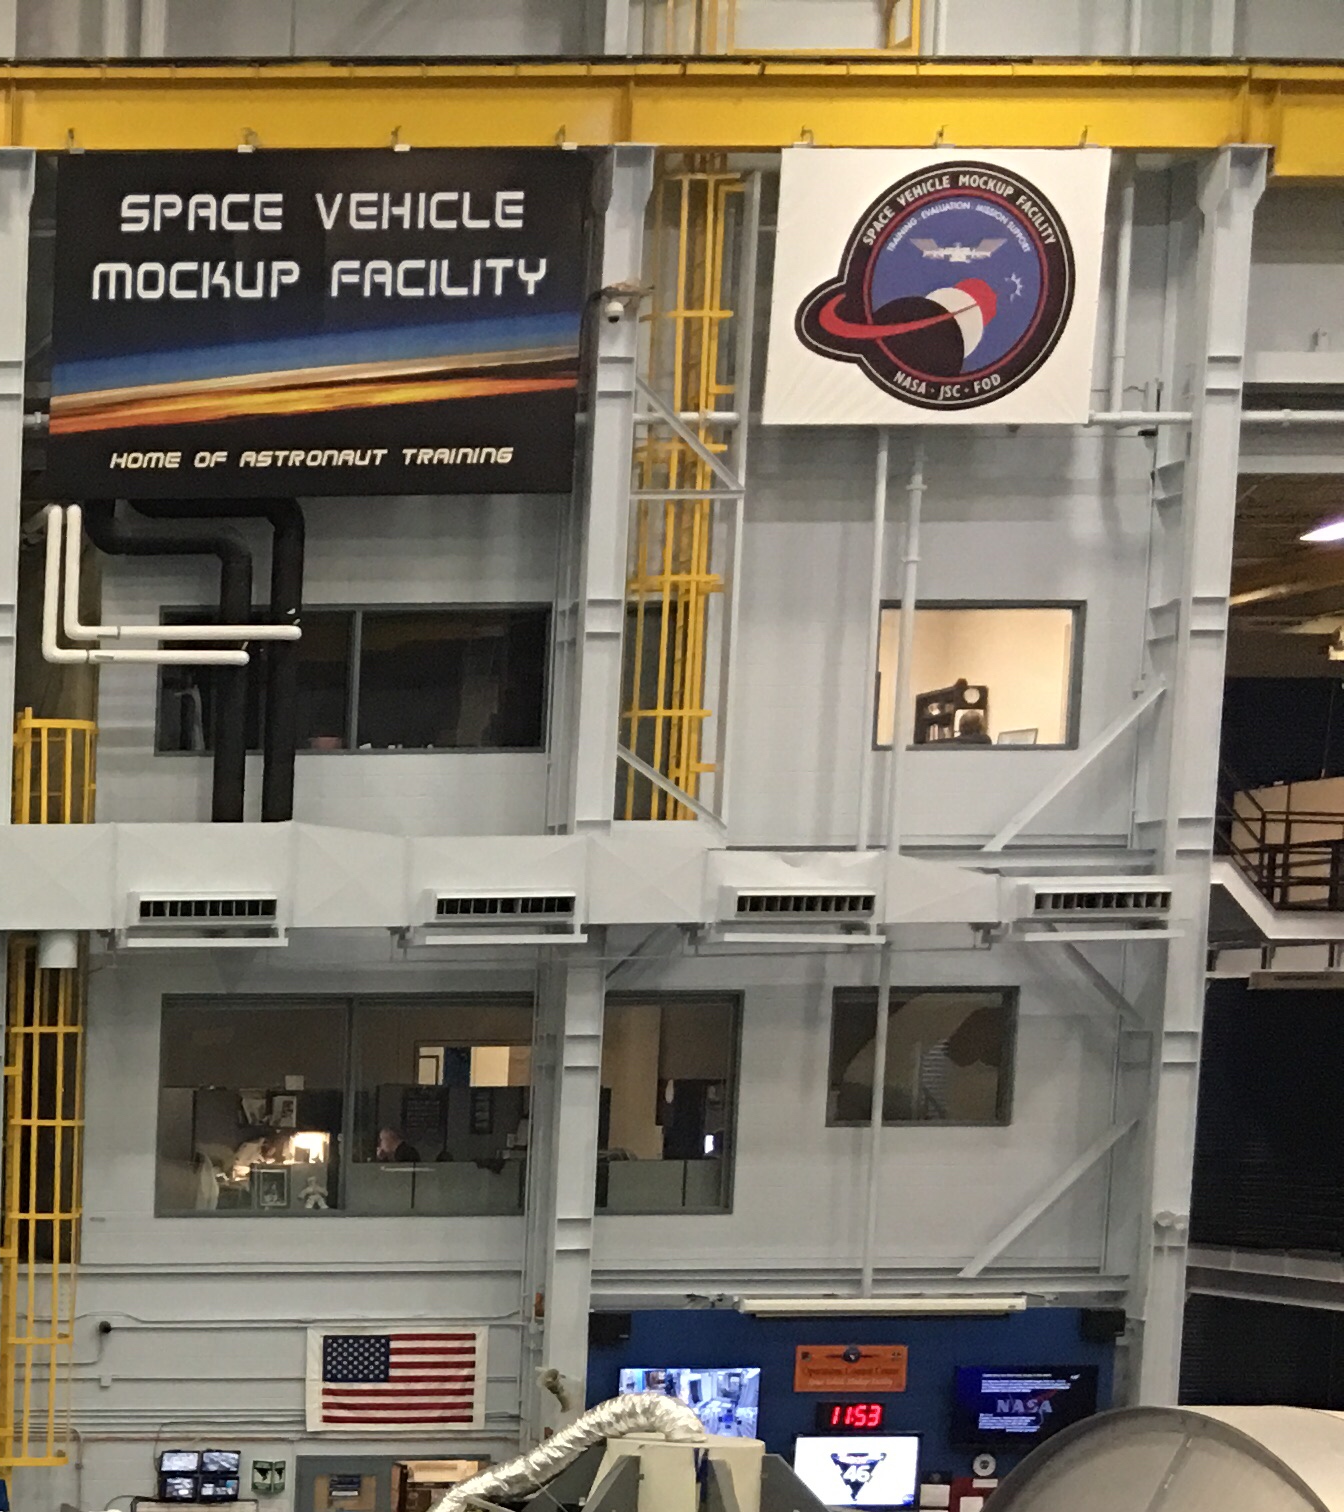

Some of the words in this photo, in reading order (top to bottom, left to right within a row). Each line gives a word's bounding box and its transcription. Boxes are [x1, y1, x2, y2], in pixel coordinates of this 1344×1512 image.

[119, 192, 284, 233] SPACE
[314, 190, 526, 231] VEHICLE
[862, 205, 896, 247] SPACE
[896, 174, 951, 208] VEHICLE
[958, 173, 1015, 199] MOCKUP
[1015, 194, 1058, 246] FACILITY
[886, 216, 919, 252] TRAINING
[920, 201, 971, 219] EVALUATION
[975, 203, 1009, 225] MISSION
[1006, 220, 1032, 253] SUPPORT
[91, 260, 301, 300] MOCKUP
[329, 256, 548, 297] FACILITY
[892, 369, 927, 395] NASA
[937, 383, 962, 401] JSC
[972, 372, 1002, 394] FOD
[109, 450, 182, 470] HOME
[193, 449, 229, 469] OF
[238, 447, 388, 468] ASTRONAUT
[400, 446, 515, 466] TRAINING
[996, 1399, 1053, 1414] NASA
[842, 1464, 872, 1483] 46
